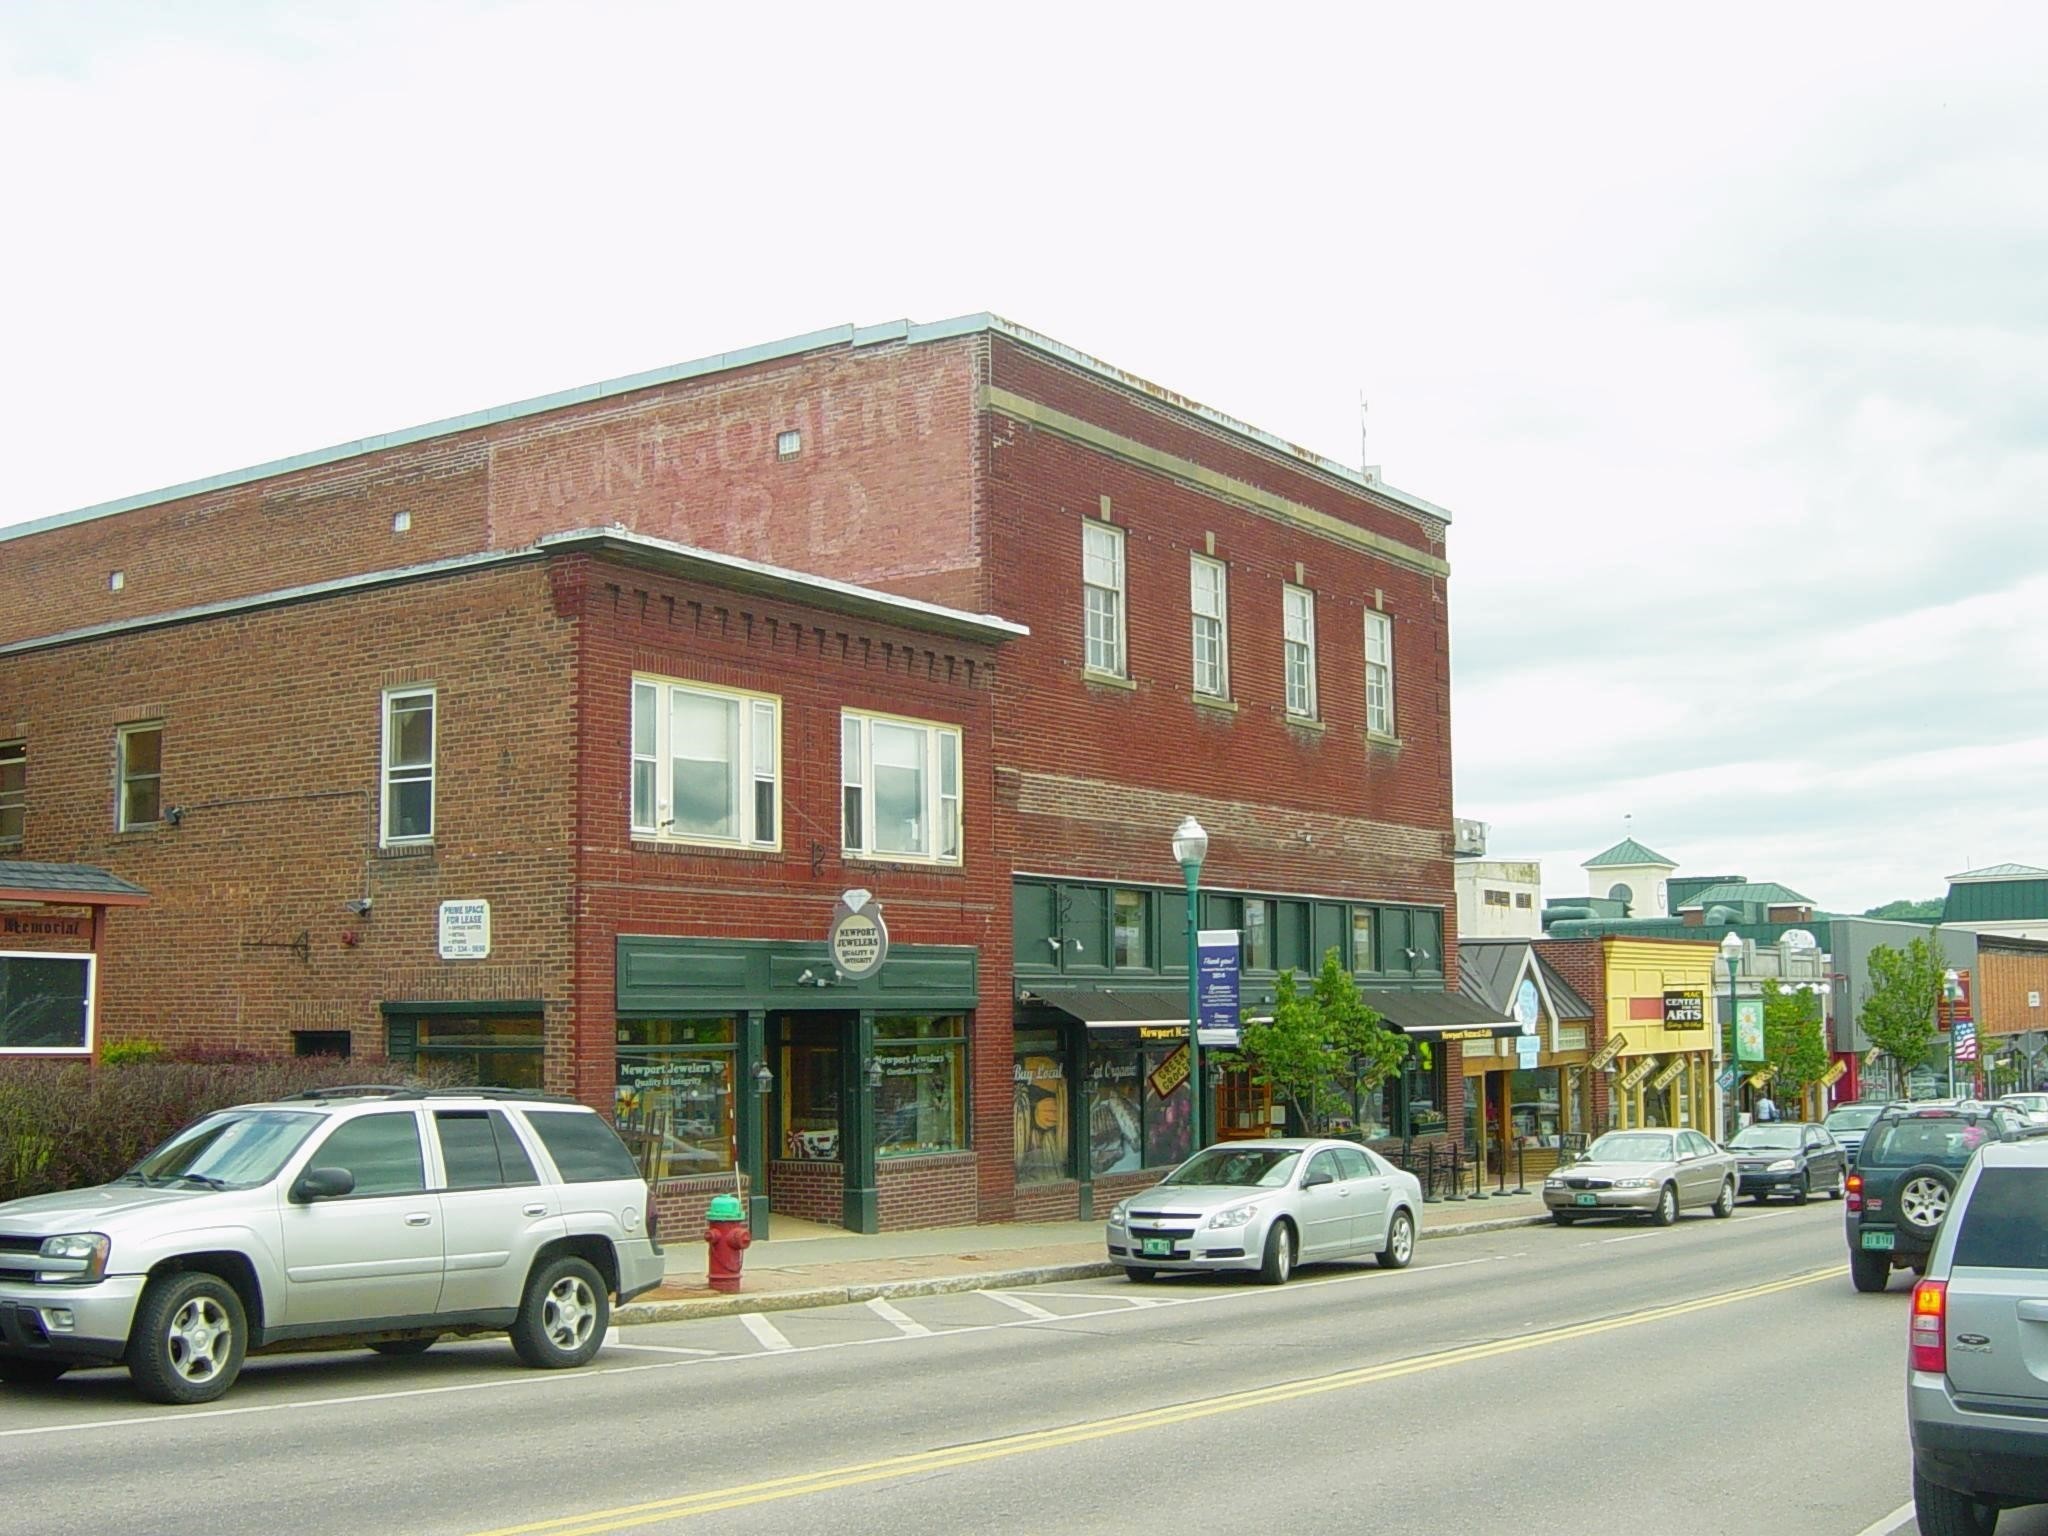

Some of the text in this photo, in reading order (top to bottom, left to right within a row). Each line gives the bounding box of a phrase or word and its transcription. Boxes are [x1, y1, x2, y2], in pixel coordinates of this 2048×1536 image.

[447, 915, 482, 924] FOR LEASE
[3, 918, 80, 935] Memorial
[840, 928, 876, 937] NEWPORT
[837, 939, 878, 947] JEWELERS
[1203, 957, 1220, 965] Thank
[1665, 998, 1701, 1006] CENTER
[1666, 1010, 1702, 1021] ARTS
[1140, 1027, 1174, 1040] Newport
[911, 1054, 944, 1064] Jewelers
[621, 1062, 711, 1077] Newport Jewelers
[1158, 1051, 1187, 1080] GREEN
[1013, 1062, 1063, 1086] Buy Local
[634, 1078, 661, 1088] Quality
[670, 1077, 702, 1087] Integrity
